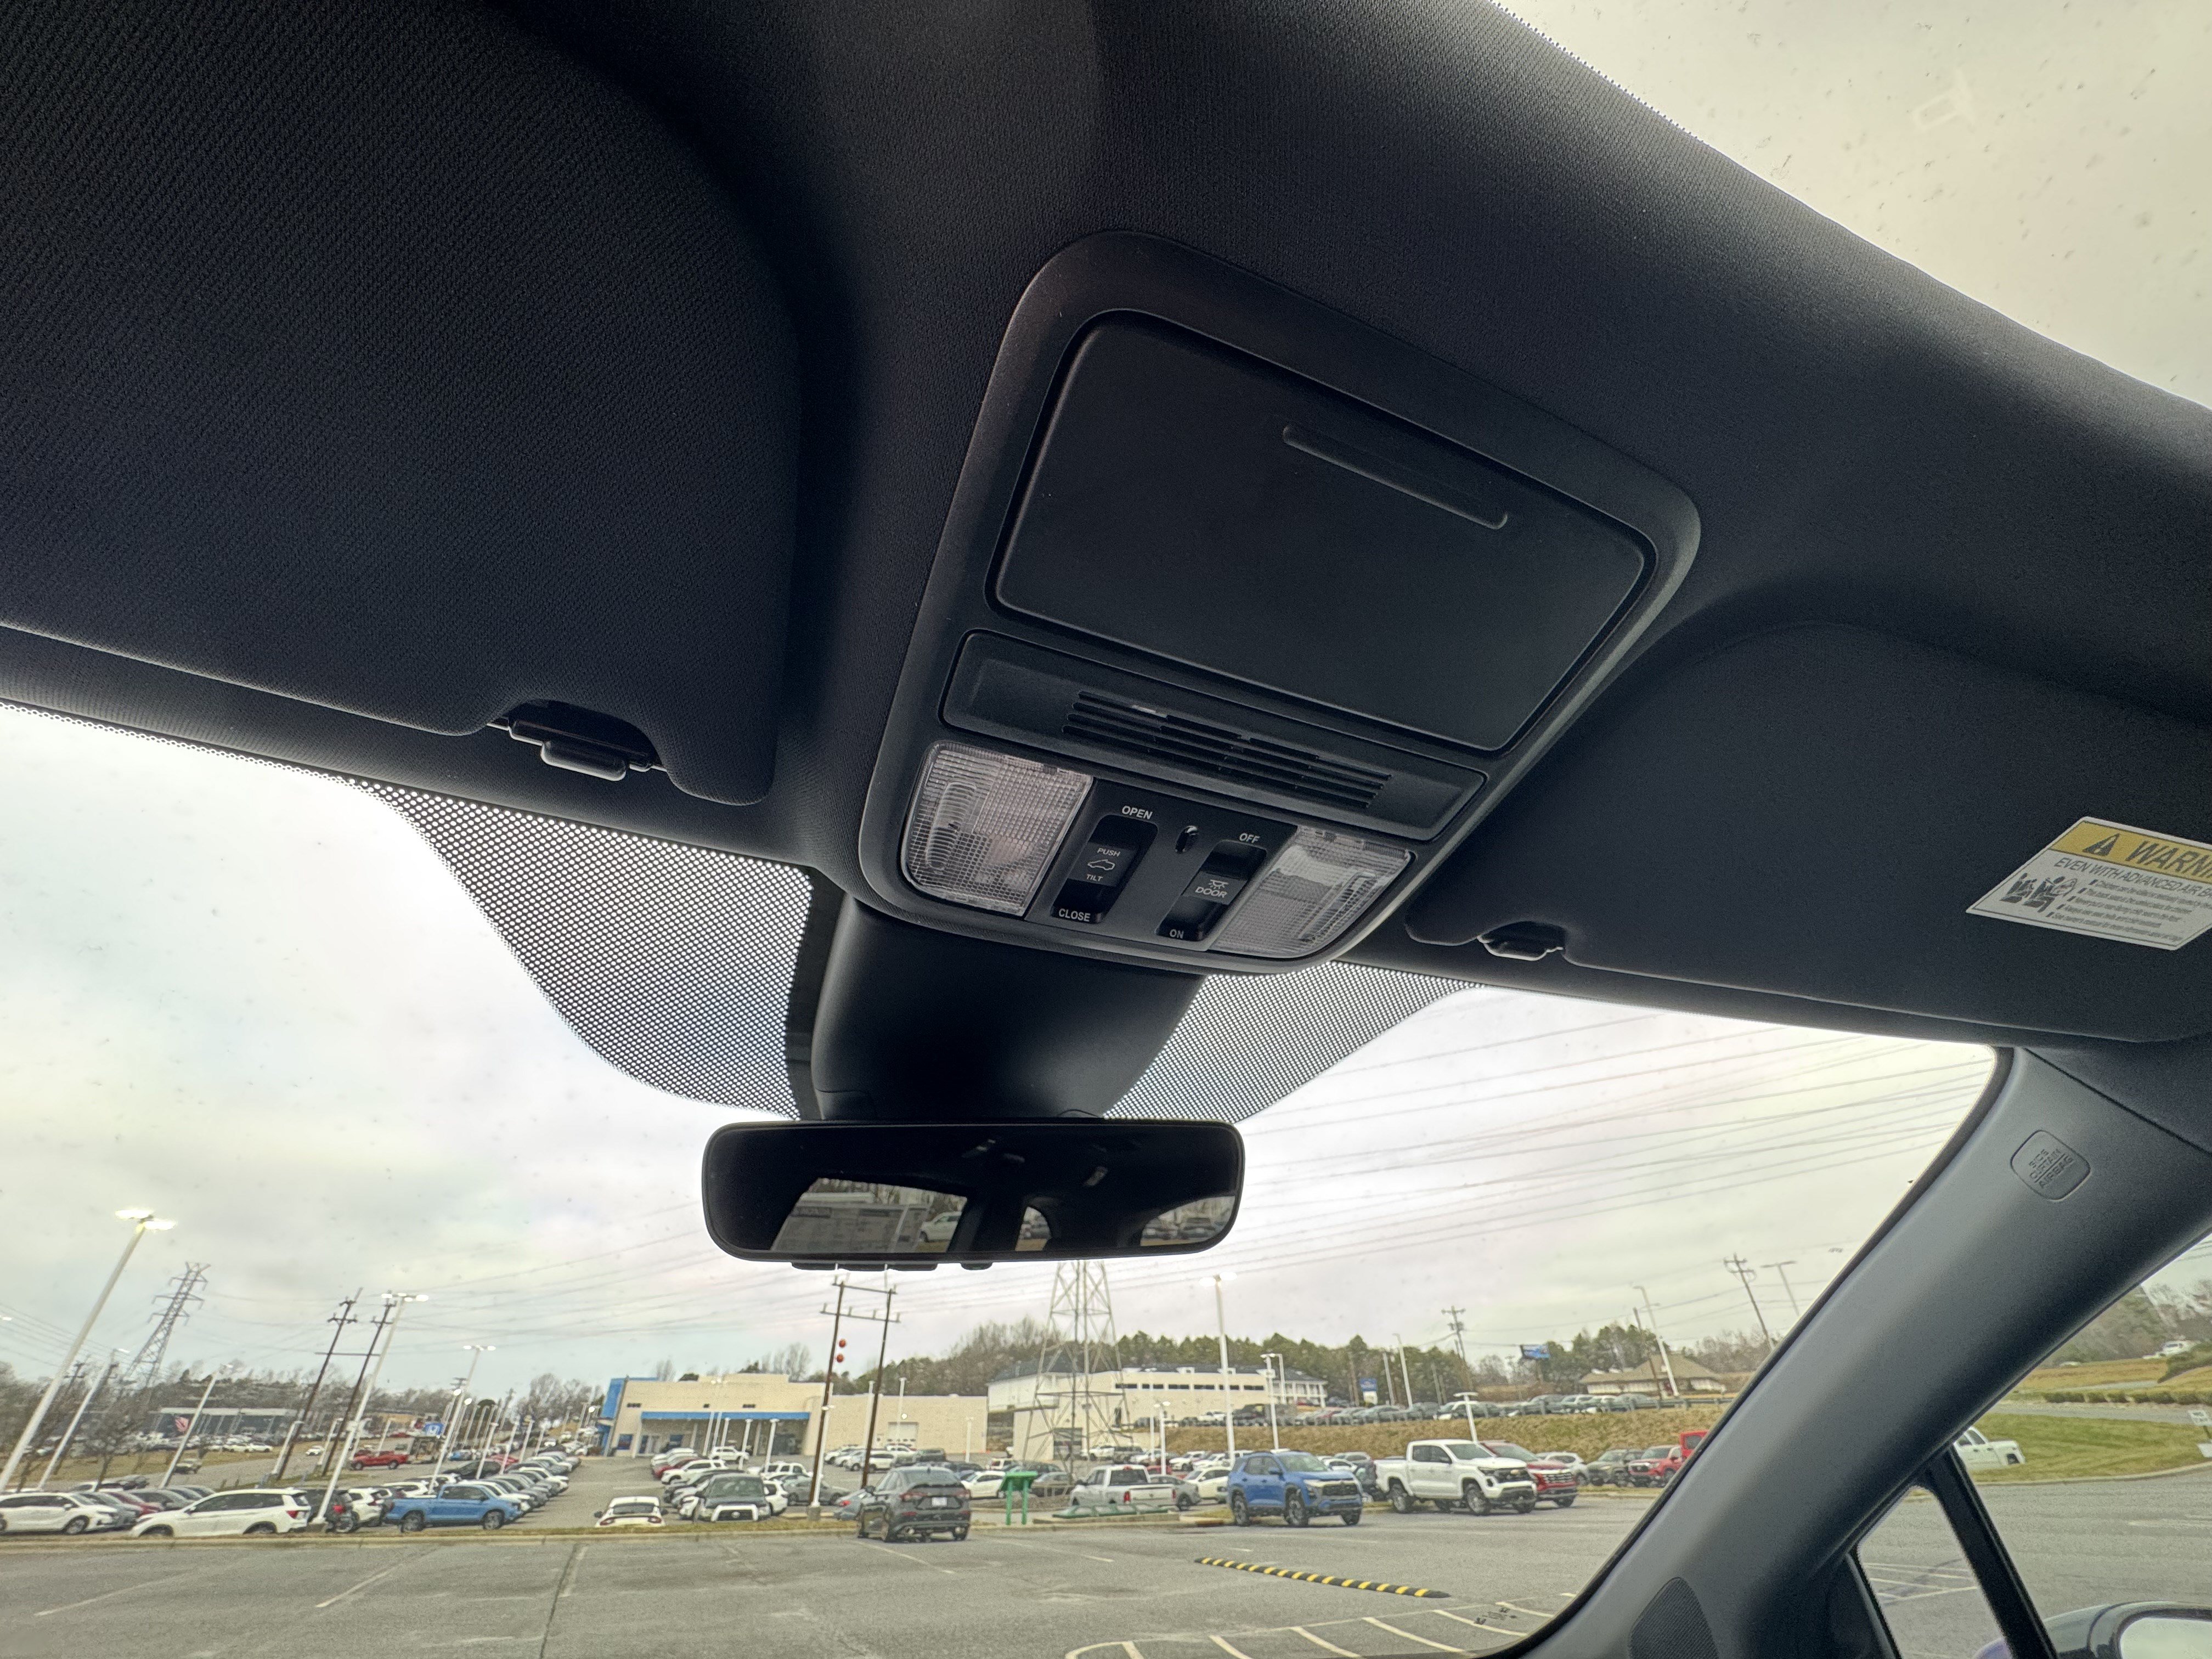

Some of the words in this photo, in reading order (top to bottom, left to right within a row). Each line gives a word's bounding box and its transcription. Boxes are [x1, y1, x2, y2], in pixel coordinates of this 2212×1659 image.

[1122, 805, 1153, 820] OPEN
[1239, 833, 1260, 843] OFF
[1097, 848, 1120, 857] PUSH
[2125, 840, 2212, 878] WARN
[2054, 857, 2092, 872] EVEN
[2089, 864, 2125, 879] WITH
[2119, 871, 2183, 891] ADVANCED
[2177, 884, 2203, 895] AIR
[1195, 887, 1227, 898] DOOR
[1058, 909, 1091, 922] CLOSE
[1169, 929, 1184, 939] ON
